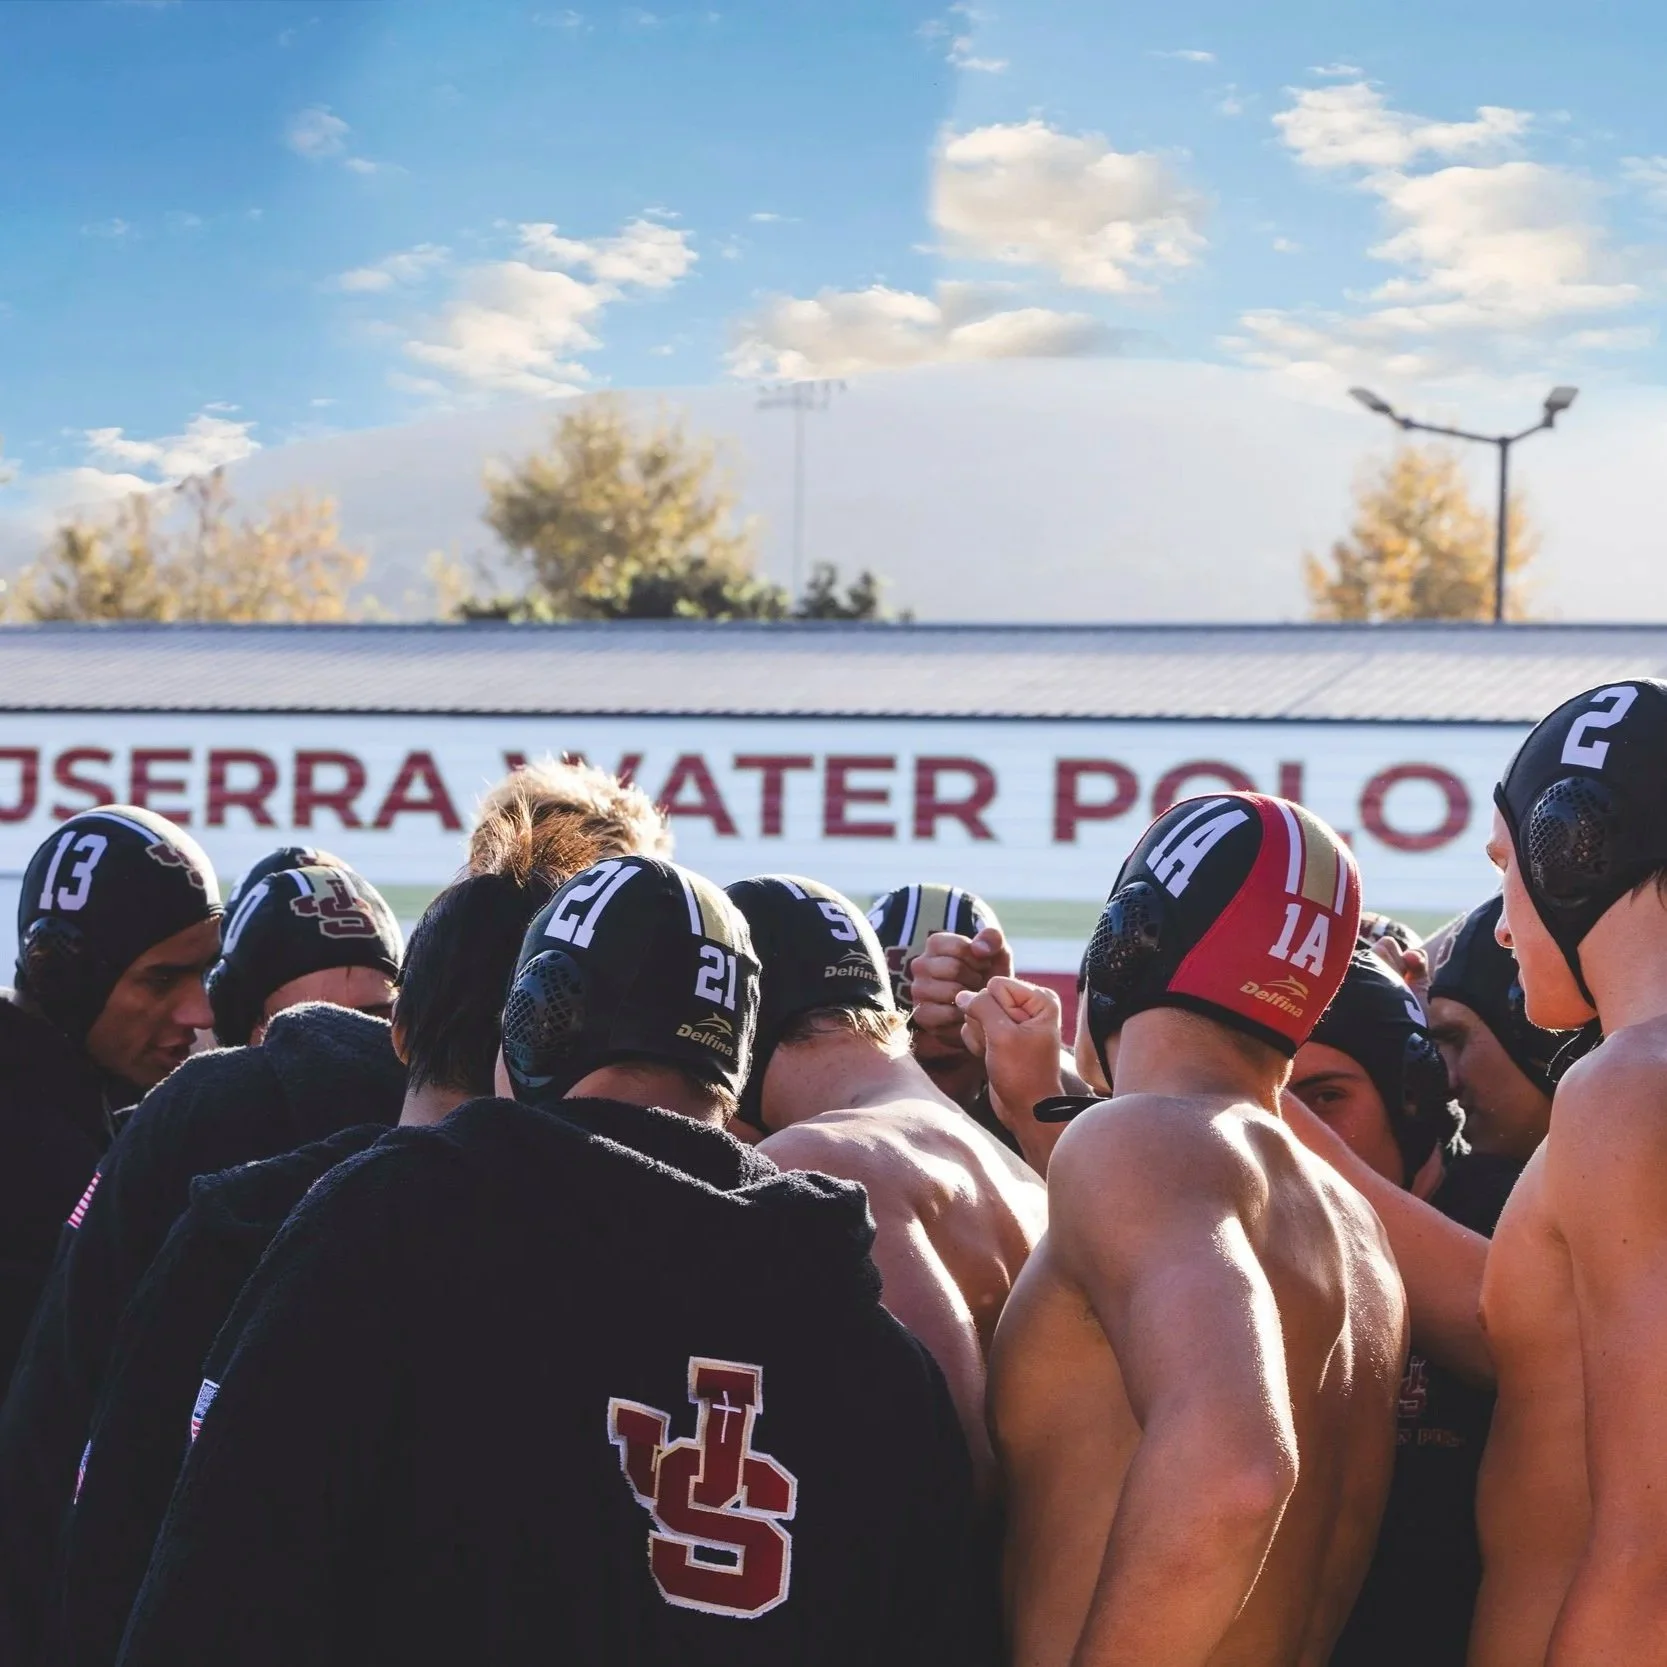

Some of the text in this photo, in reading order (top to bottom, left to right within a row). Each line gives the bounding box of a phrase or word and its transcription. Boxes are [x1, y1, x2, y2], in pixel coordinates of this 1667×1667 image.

[1560, 685, 1639, 770] 2
[38, 830, 108, 911] 13
[1146, 797, 1250, 899] 1A
[544, 859, 643, 949] 21
[817, 902, 858, 943] 5
[1268, 903, 1330, 977] 1A
[694, 944, 737, 1012] 21
[1239, 980, 1304, 1018] Delfina
[675, 1023, 734, 1057] Delfina
